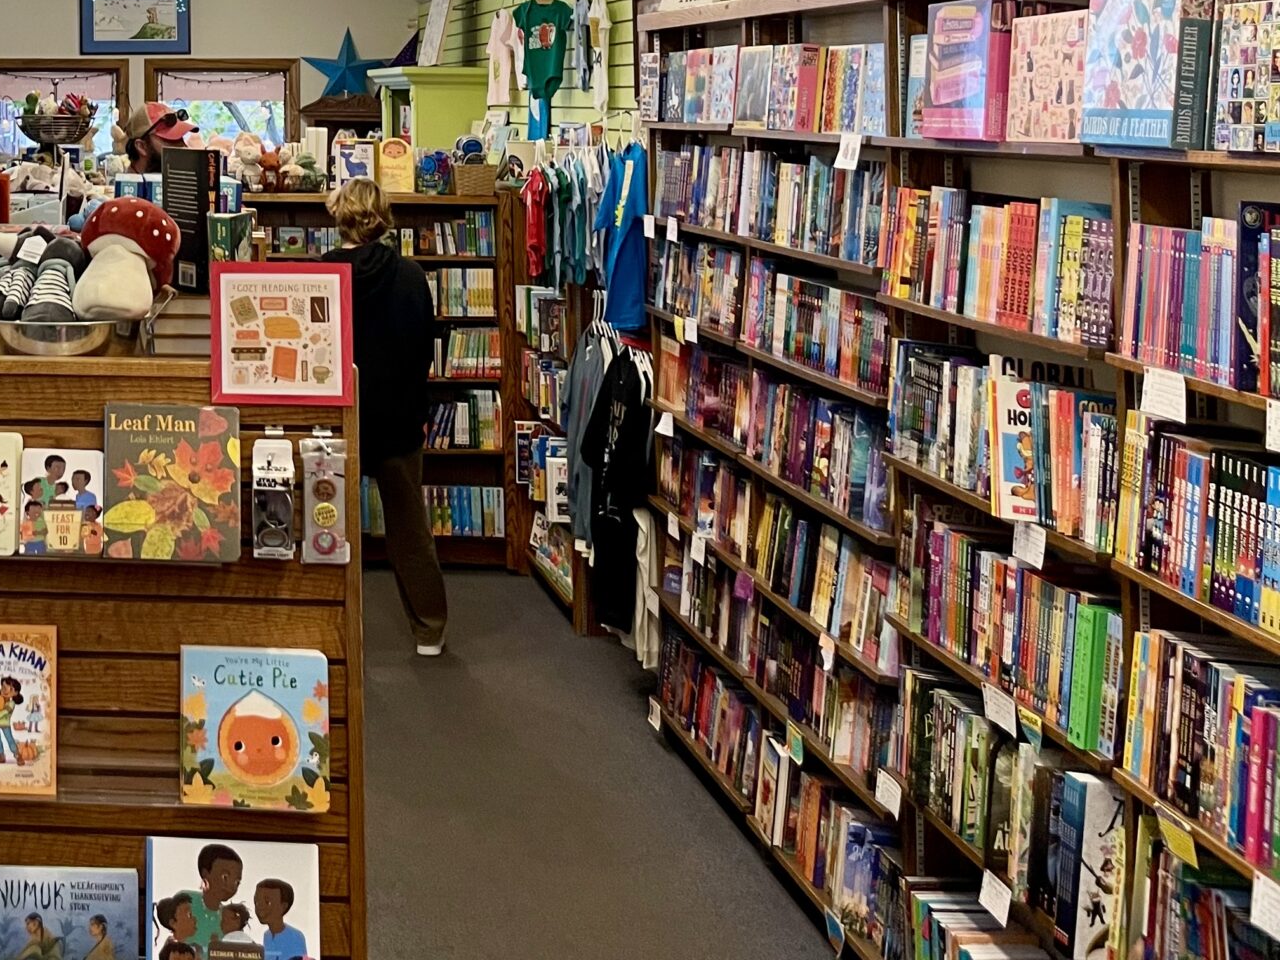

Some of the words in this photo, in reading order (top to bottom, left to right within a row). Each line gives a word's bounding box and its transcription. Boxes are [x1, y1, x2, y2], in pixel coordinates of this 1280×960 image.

[1181, 25, 1199, 78] FEATHER
[1179, 89, 1194, 107] OF
[1083, 115, 1108, 135] BIRDS
[1109, 116, 1119, 135] OF
[1128, 118, 1168, 138] FEATHER
[1176, 108, 1192, 144] BIRDS
[237, 283, 258, 293] COZY
[261, 283, 299, 293] READING
[302, 283, 321, 293] TIME
[109, 413, 150, 431] Leaf
[155, 414, 196, 432] Man
[130, 434, 147, 443] Lois
[148, 434, 174, 444] Ehlert
[51, 513, 75, 523] FEAST
[55, 524, 71, 535] FOR
[58, 535, 68, 546] 10
[9, 642, 47, 672] KHAN
[224, 655, 248, 665] You're
[251, 657, 263, 667] My
[266, 658, 290, 668] Little
[214, 664, 264, 687] Cutie
[272, 666, 298, 689] Pie
[70, 891, 121, 902] THANKSGIVING
[70, 902, 90, 912] STORY
